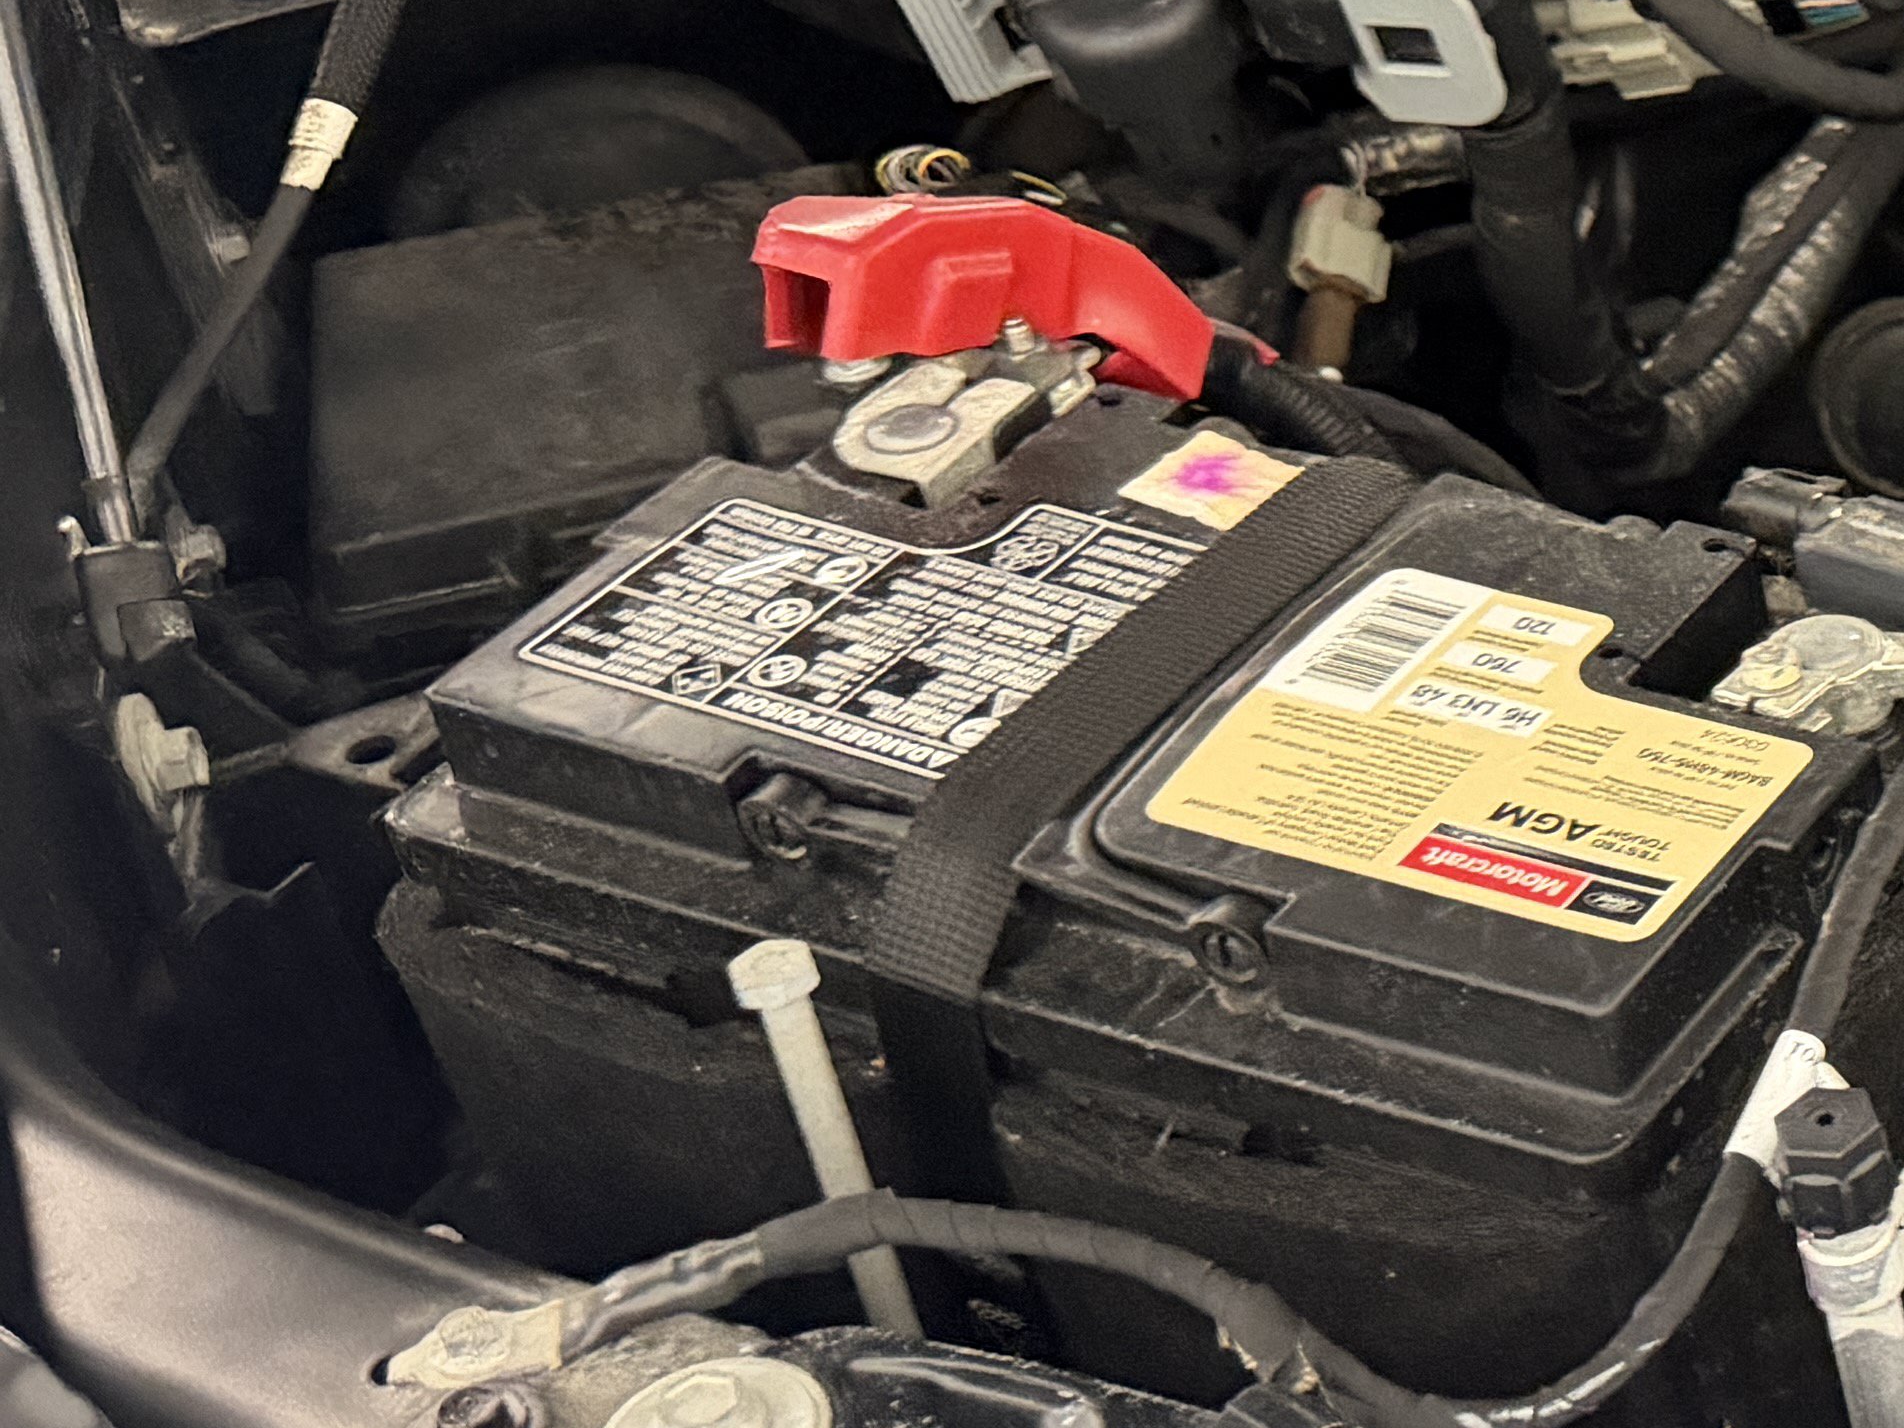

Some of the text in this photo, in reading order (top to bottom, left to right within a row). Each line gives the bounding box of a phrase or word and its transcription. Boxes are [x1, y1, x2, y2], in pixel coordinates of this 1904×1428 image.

[1512, 616, 1556, 635] 120
[1472, 653, 1522, 673] 760
[1410, 684, 1448, 701] 48
[1447, 694, 1501, 716] LN3
[722, 691, 936, 763] DANGER/POISON
[1487, 801, 1602, 841] AGM
[1592, 837, 1661, 862] TESTED
[1419, 846, 1570, 898] Motorcraft
